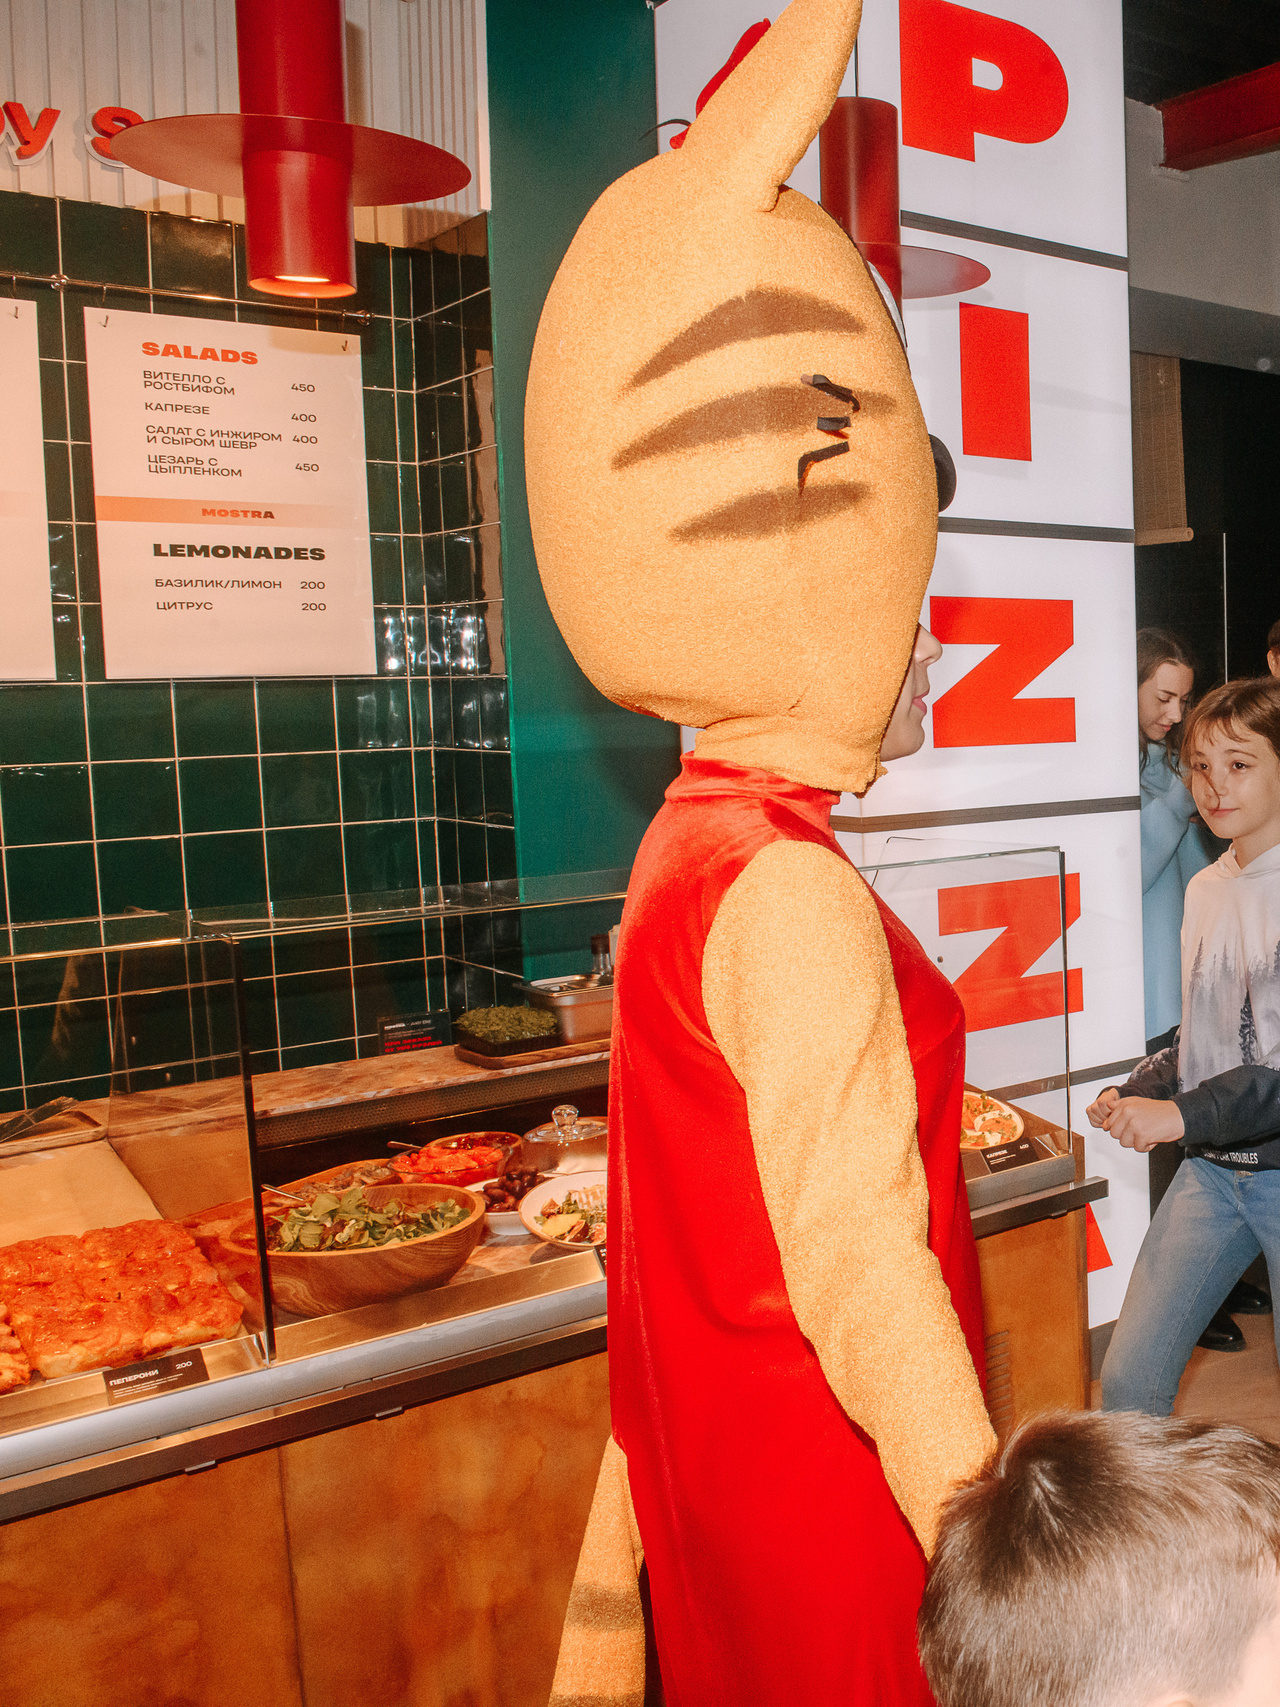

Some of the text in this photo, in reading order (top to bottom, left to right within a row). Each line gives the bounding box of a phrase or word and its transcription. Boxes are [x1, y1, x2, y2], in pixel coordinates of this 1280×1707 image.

[0, 101, 62, 160] y
[141, 341, 259, 365] SALADS
[143, 370, 226, 385] ВИТЕЛЛО С
[144, 380, 235, 395] РОСТБИФОМ
[291, 383, 316, 393] 450
[145, 402, 210, 415] КАПРЕЗЕ
[291, 413, 317, 423] 400
[146, 425, 282, 442] САЛАТ С ИНЖИРОМ
[292, 435, 318, 444] 400
[146, 435, 257, 450] И СЫРОМ ШЕВР
[147, 454, 218, 466] ЦЕЗАРЬ С
[148, 465, 243, 477] ЦЫПЛЕНКОМ
[295, 463, 320, 472] 450
[201, 508, 276, 519] MOSTRA
[153, 543, 326, 561] LEMONADES
[155, 578, 326, 590] БАЗИЛИК/ЛИМОН 200
[156, 601, 327, 611] ЦИТРУС 200
[899, 0, 1113, 1273] PIZZ
[1229, 1151, 1259, 1165] TROUBLES
[109, 1369, 159, 1386] ПЕПЕРОНИ
[175, 1360, 193, 1370] 200
